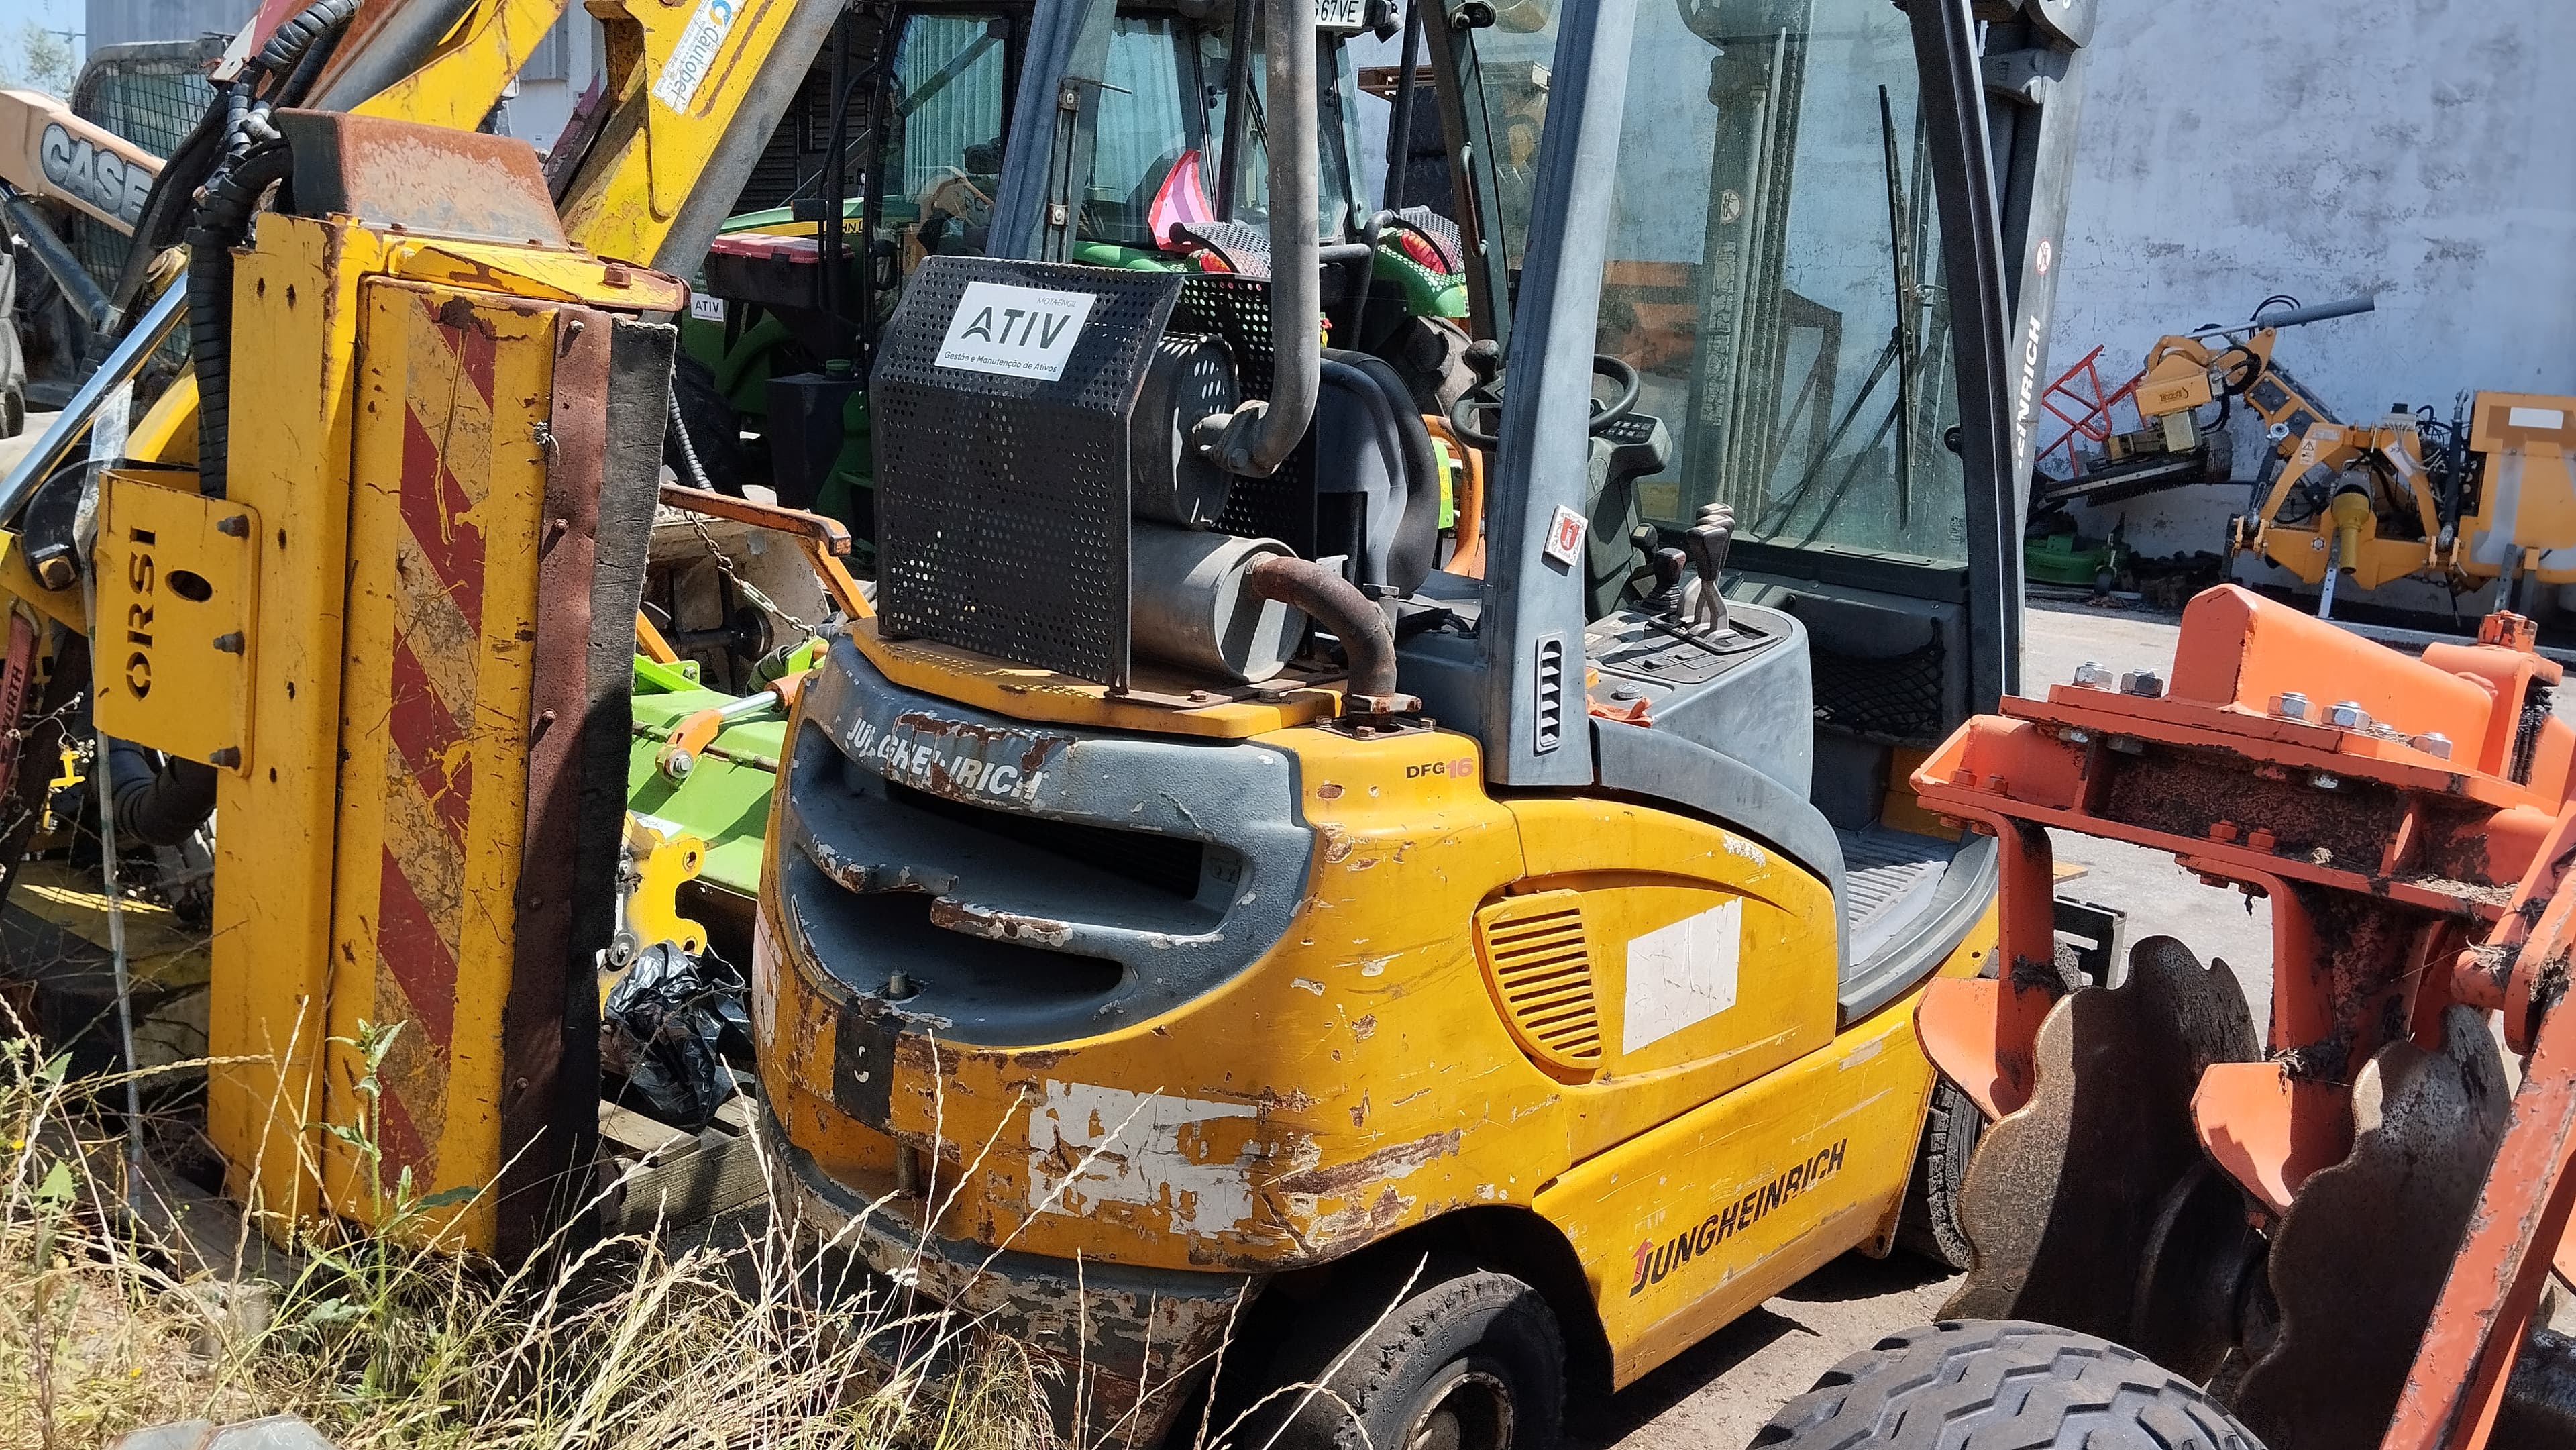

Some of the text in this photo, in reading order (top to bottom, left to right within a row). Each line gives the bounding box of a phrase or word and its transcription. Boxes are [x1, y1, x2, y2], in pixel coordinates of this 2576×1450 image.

[41, 123, 154, 227] CASE
[695, 299, 720, 313] ATIV
[961, 306, 1071, 349] ATIV
[944, 351, 969, 362] Gestão
[977, 355, 1022, 368] Manutenção
[1023, 361, 1033, 370] de
[1034, 362, 1057, 373] Ativos
[126, 525, 156, 702] ORSI
[1629, 1138, 1848, 1298] JUNGHEINRICH
